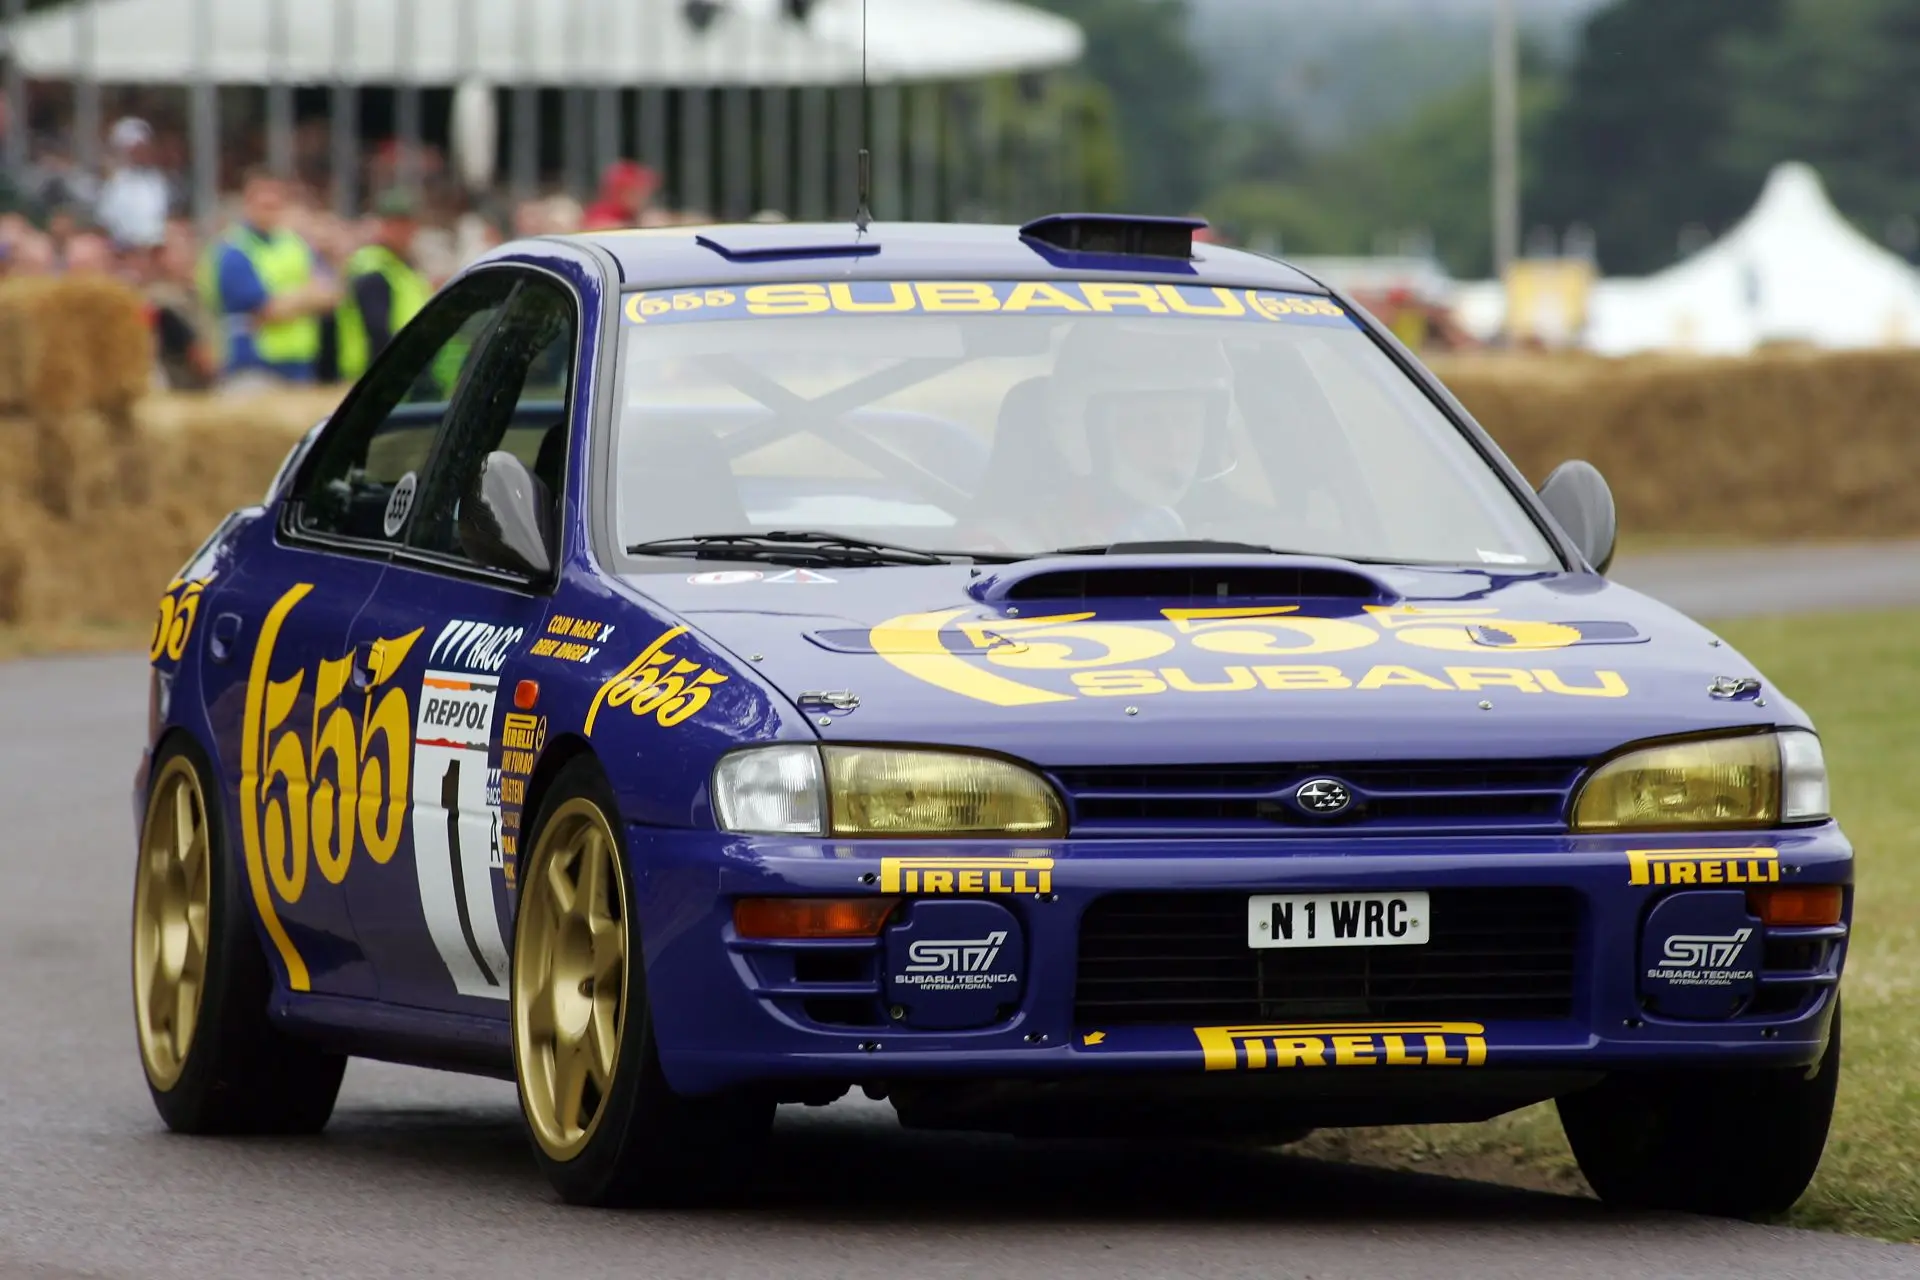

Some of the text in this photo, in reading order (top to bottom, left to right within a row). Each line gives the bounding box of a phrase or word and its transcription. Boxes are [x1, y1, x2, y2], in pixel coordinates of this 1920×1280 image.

[744, 281, 1246, 317] SUBARU
[547, 614, 574, 636] COLIN
[1070, 664, 1629, 699] SUBARU
[423, 698, 488, 730] REPSOL
[502, 712, 538, 750] PIRELLI
[441, 759, 500, 987] 1
[880, 857, 1055, 893] PIRELLI
[1625, 848, 1780, 886] PIRELLI
[1271, 899, 1408, 940] N 1 WRC
[895, 973, 1018, 984] SUBARU TECNICA
[920, 983, 993, 991] INTERNATIONAL
[1647, 969, 1754, 980] SUBARU TECNICA
[1669, 978, 1732, 986] INTERNATIONAL
[1193, 1021, 1488, 1071] PIRELLI
